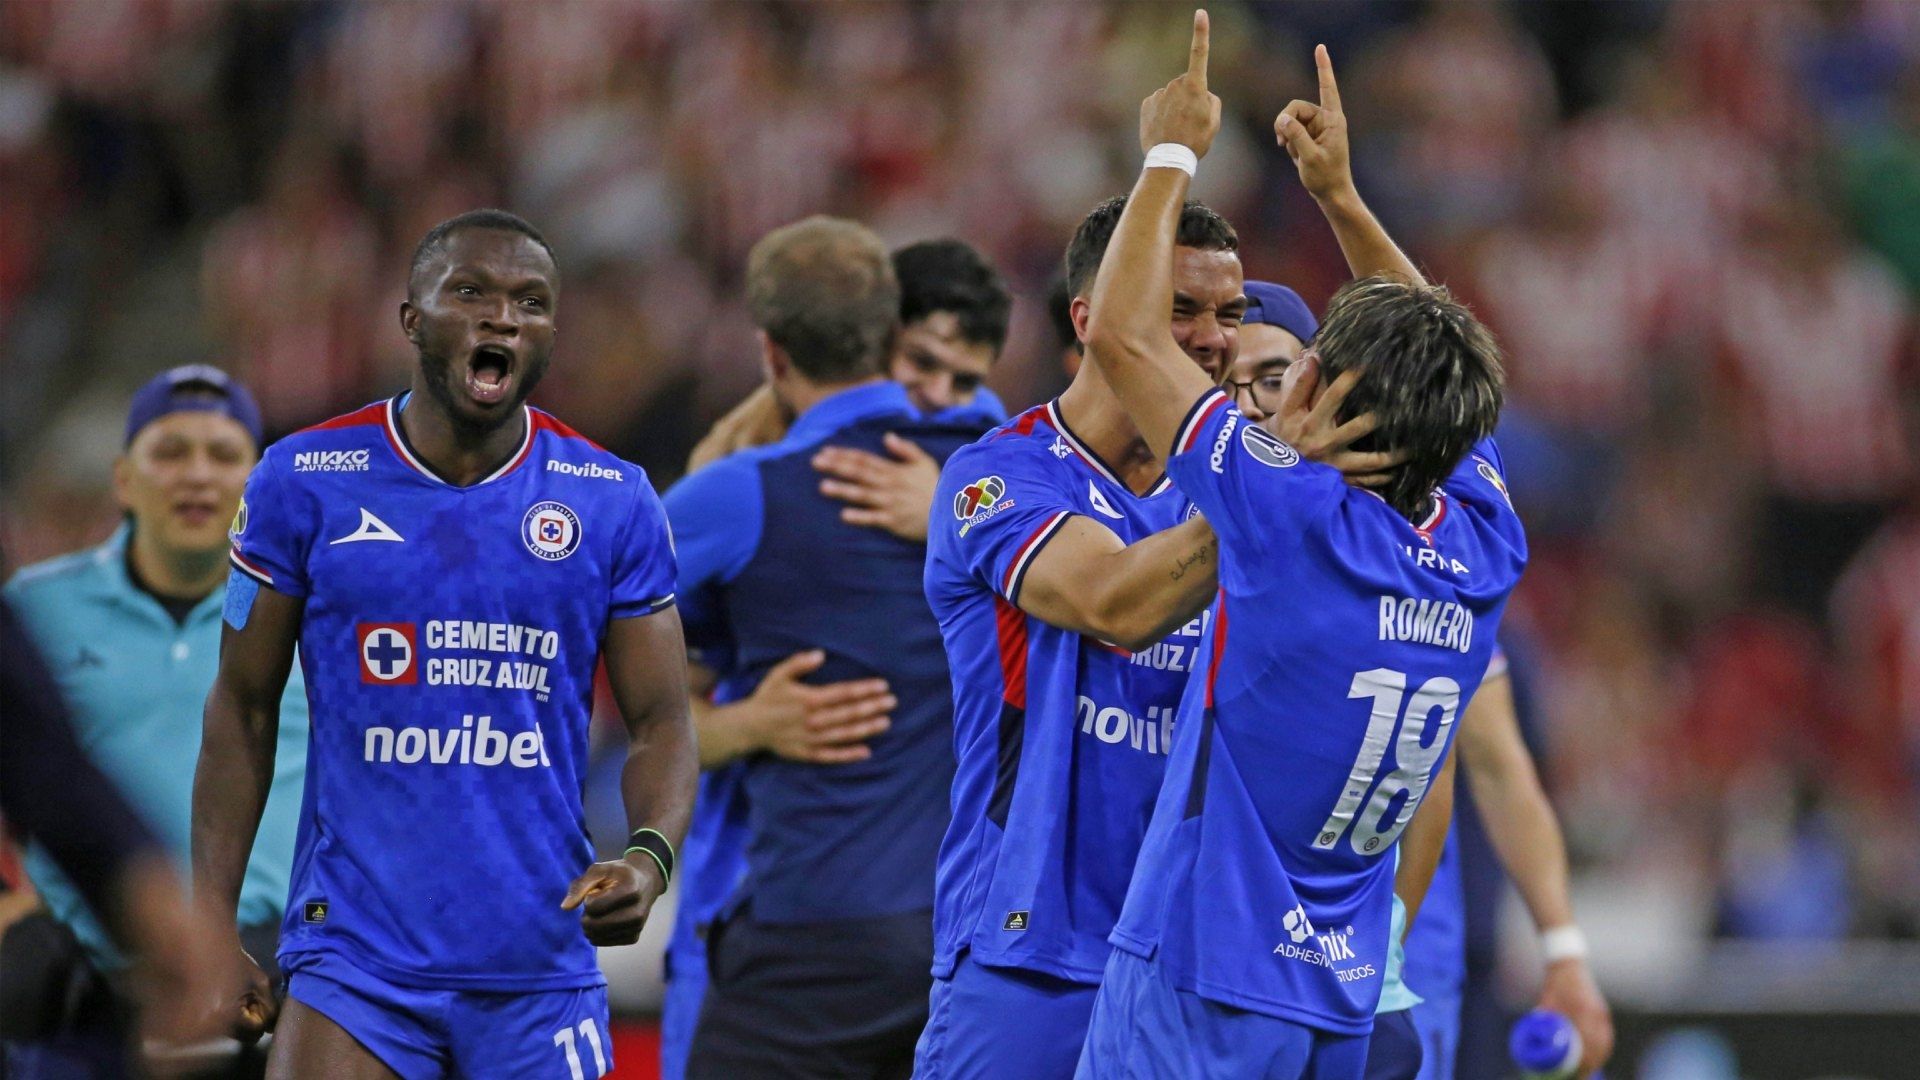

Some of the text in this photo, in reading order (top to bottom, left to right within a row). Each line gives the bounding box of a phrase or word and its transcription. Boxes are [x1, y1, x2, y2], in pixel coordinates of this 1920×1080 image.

[294, 449, 370, 466] NIKKO
[546, 459, 624, 482] novibet
[970, 506, 999, 527] BBVA
[426, 619, 559, 660] CEMENTO
[1378, 595, 1473, 654] ROMERO
[1130, 642, 1185, 672] RUZ
[426, 658, 551, 693] CRUZ AZUL
[1311, 667, 1461, 856] 18
[553, 1017, 606, 1080] 11
